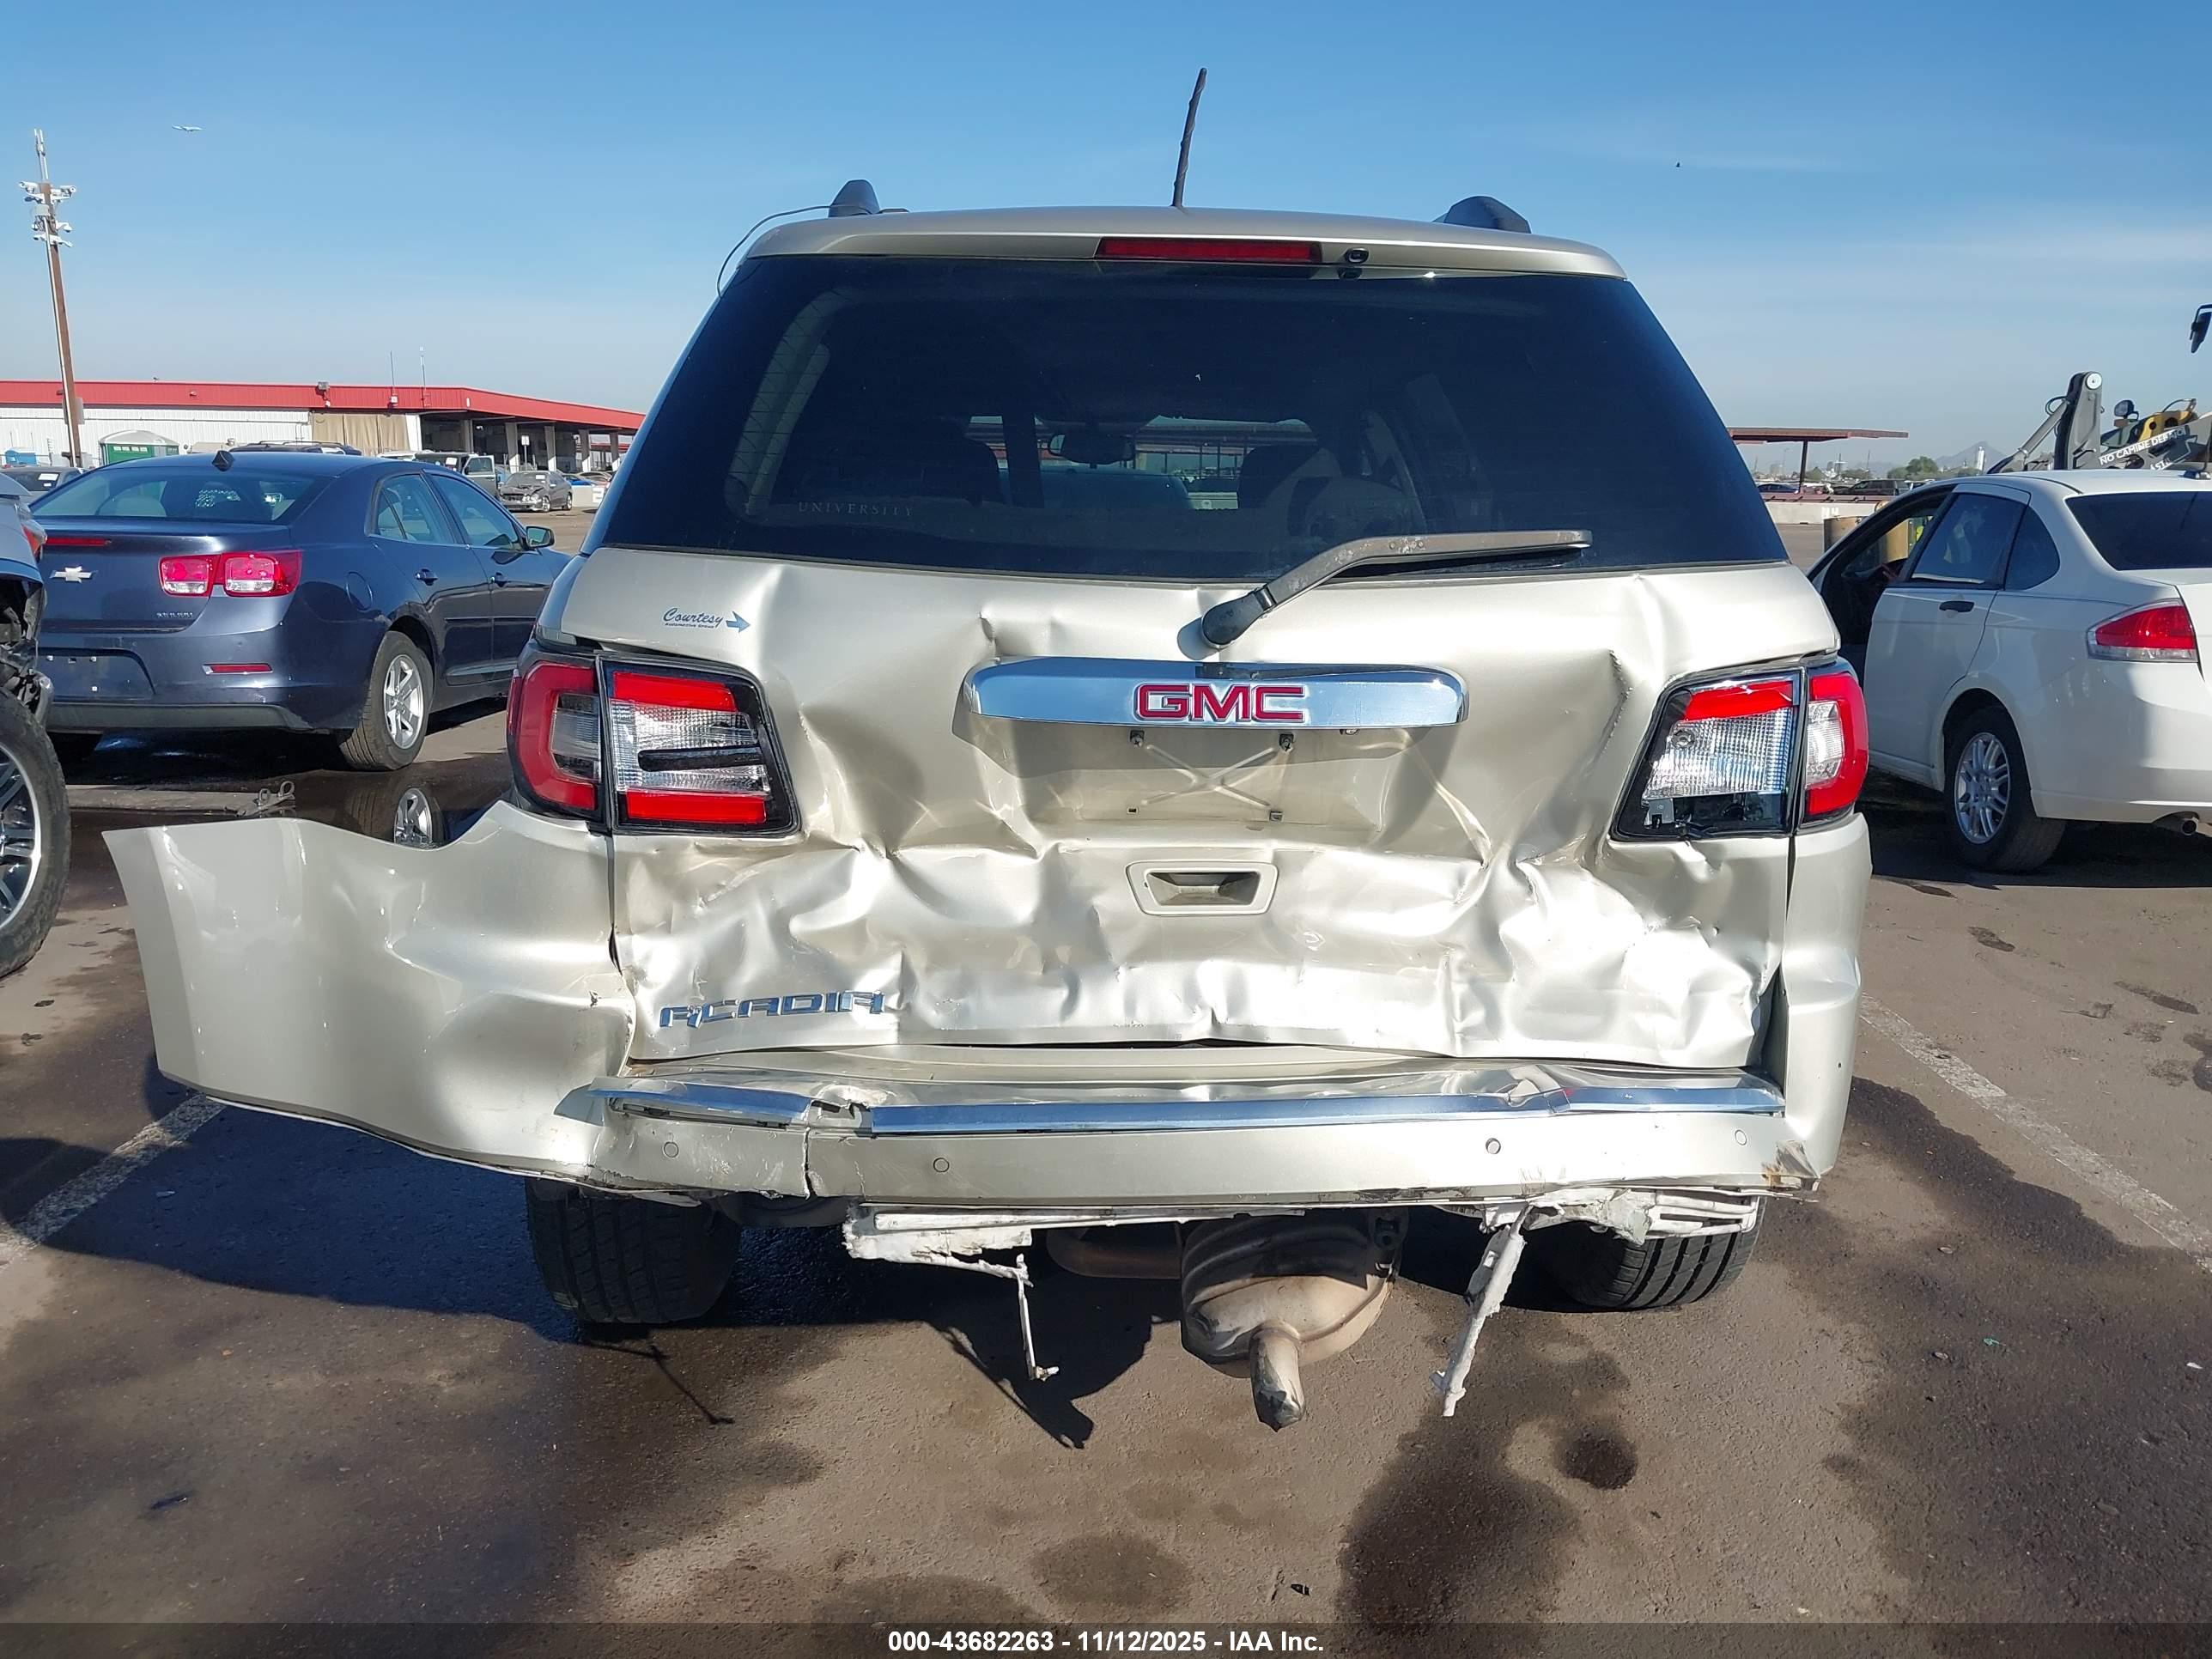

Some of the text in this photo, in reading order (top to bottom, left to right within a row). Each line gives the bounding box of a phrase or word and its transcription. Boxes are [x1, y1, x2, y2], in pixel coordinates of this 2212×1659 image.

[2100, 454, 2115, 465] NO
[798, 501, 915, 516] UNIVERSITY
[663, 607, 724, 629] Courtesy
[1134, 682, 1306, 724] GMC
[659, 989, 886, 1029] ACADIA
